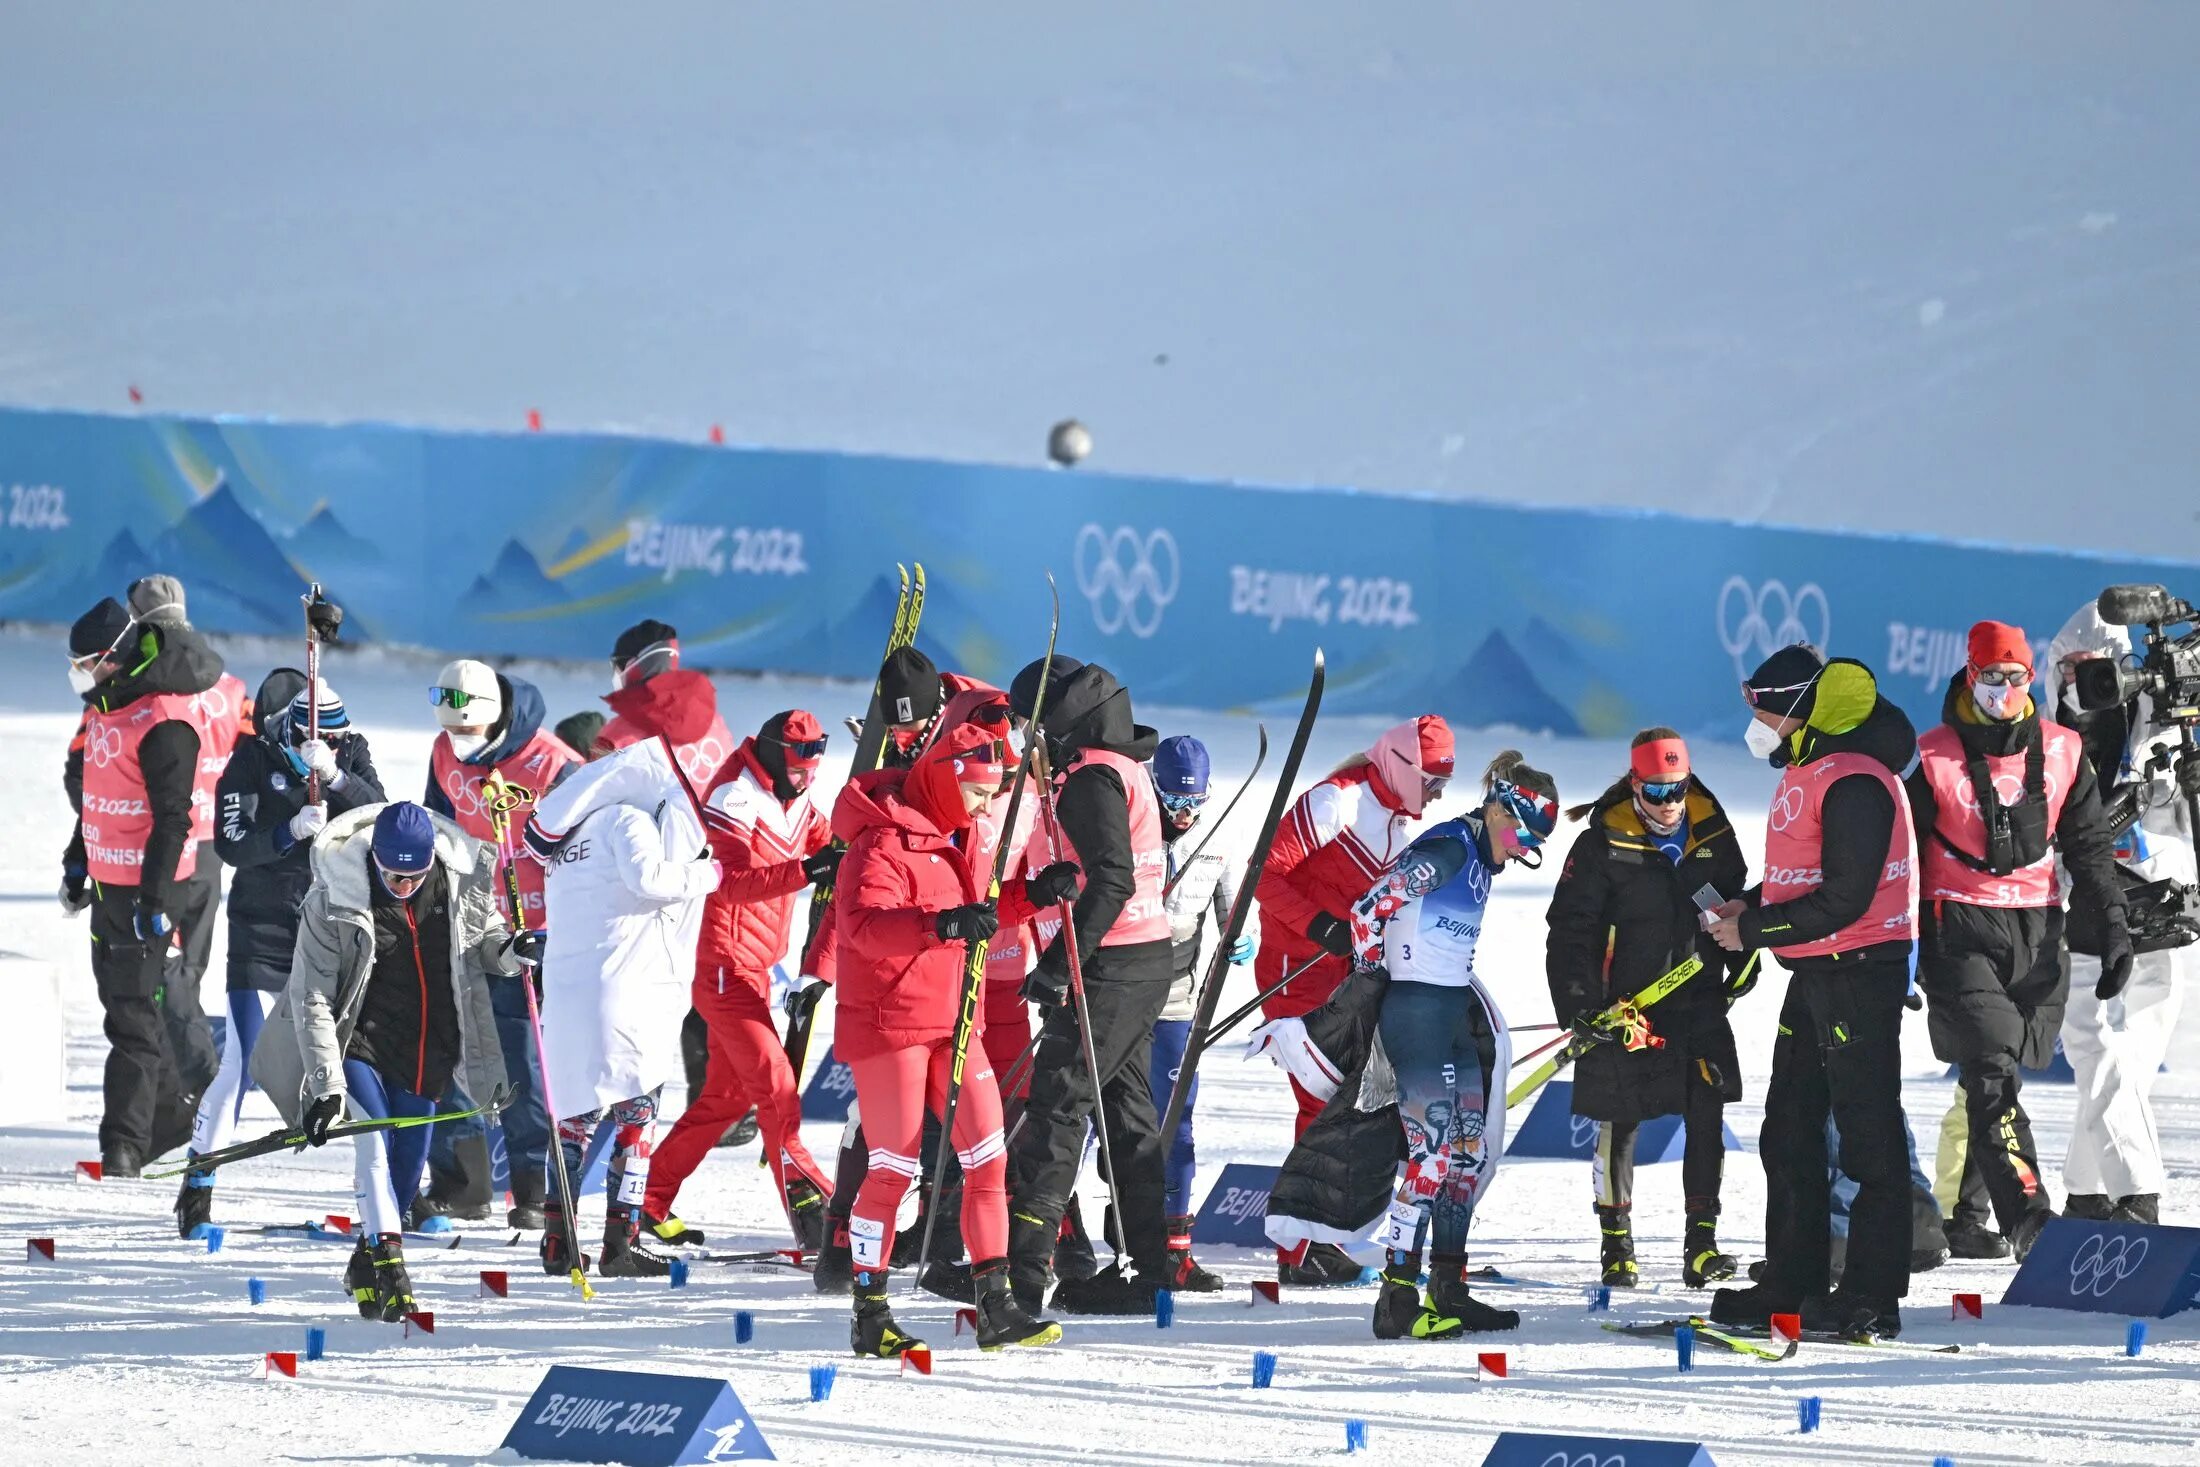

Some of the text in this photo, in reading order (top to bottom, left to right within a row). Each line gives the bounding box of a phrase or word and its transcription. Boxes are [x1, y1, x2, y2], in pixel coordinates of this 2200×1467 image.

[625, 519, 808, 583] BEIJING 2022
[1230, 565, 1418, 633] BEIJING 2022
[98, 799, 148, 816] 2022
[1769, 865, 1823, 886] 2022
[1997, 884, 2021, 903] 51
[1402, 944, 1412, 961] 3
[1657, 961, 1695, 995] FISCHER
[1392, 1226, 1402, 1241] 3
[858, 1242, 867, 1256] 1
[534, 1394, 683, 1438] BEIJING 2022
